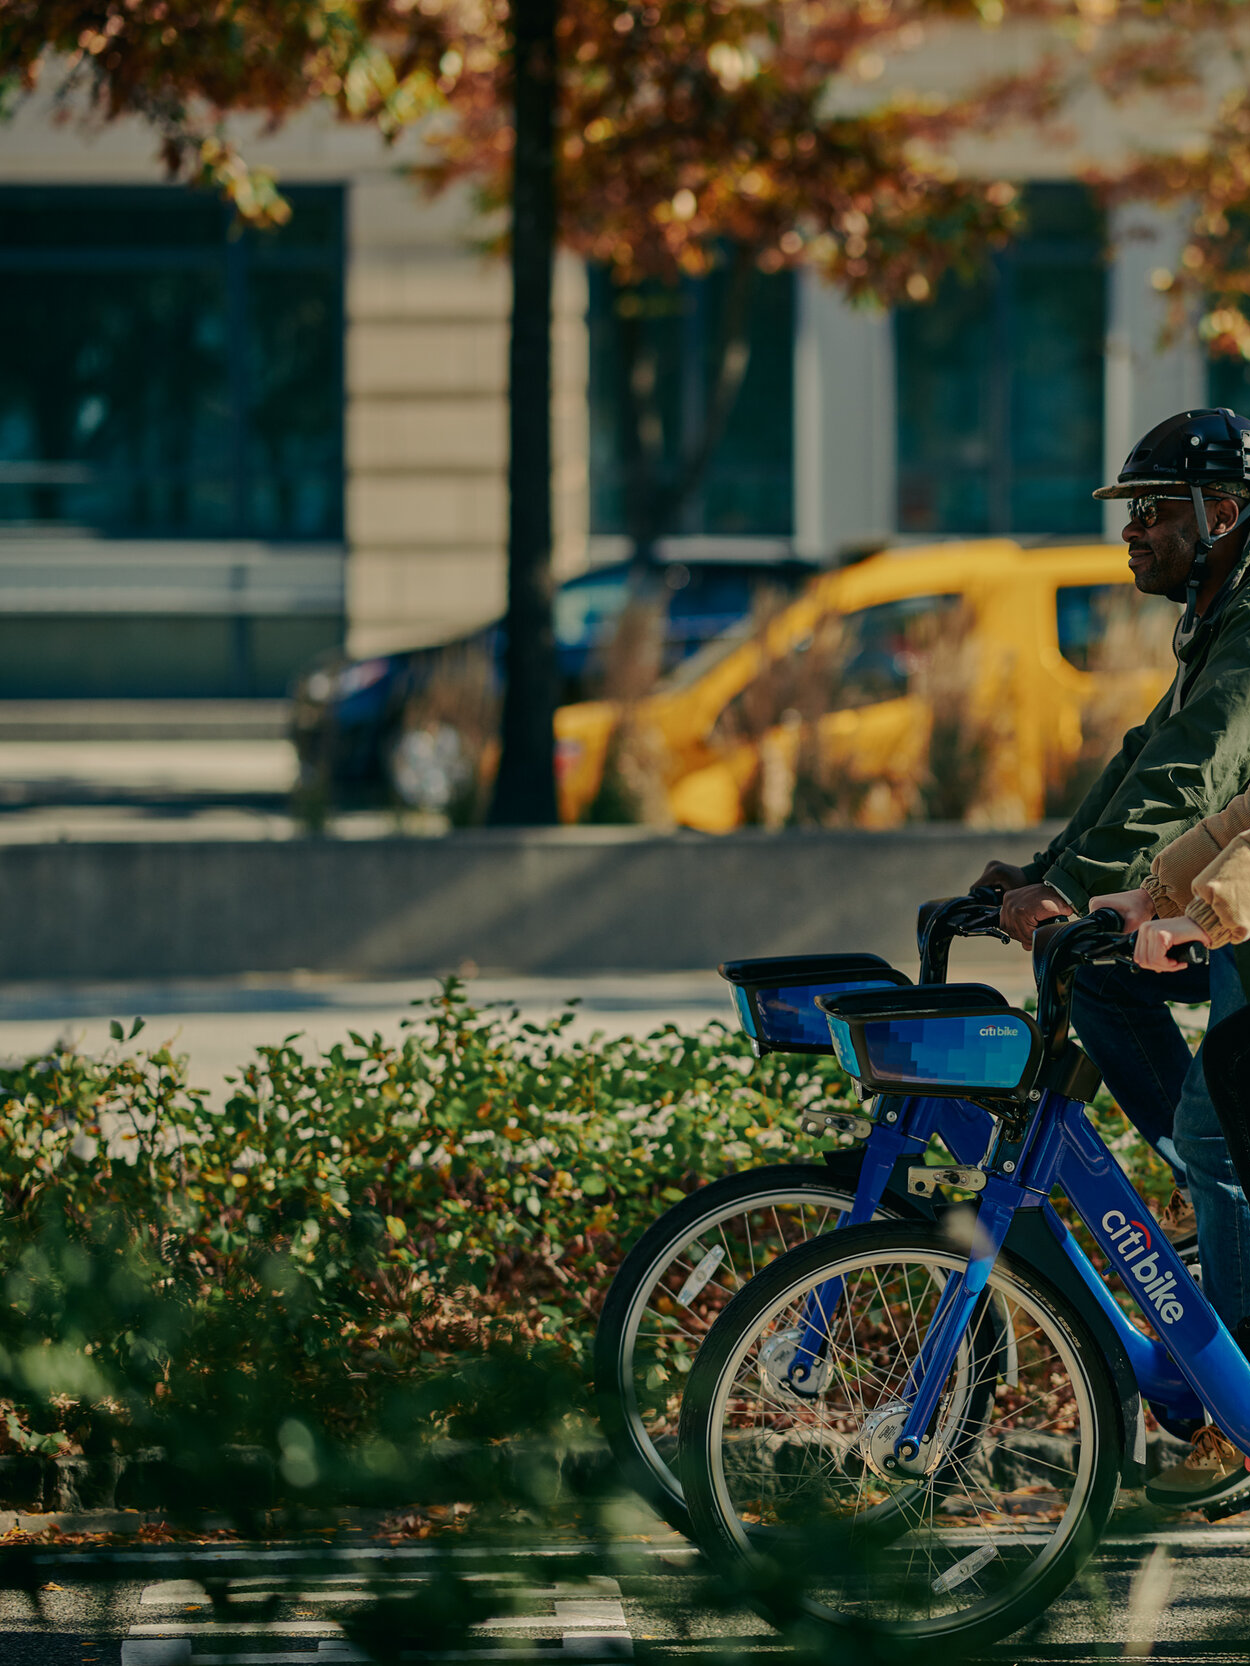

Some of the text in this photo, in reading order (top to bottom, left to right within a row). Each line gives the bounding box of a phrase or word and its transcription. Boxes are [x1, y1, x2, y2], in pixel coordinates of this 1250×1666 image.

[979, 1025, 1018, 1036] citi bike
[1101, 1209, 1184, 1325] citi bike
